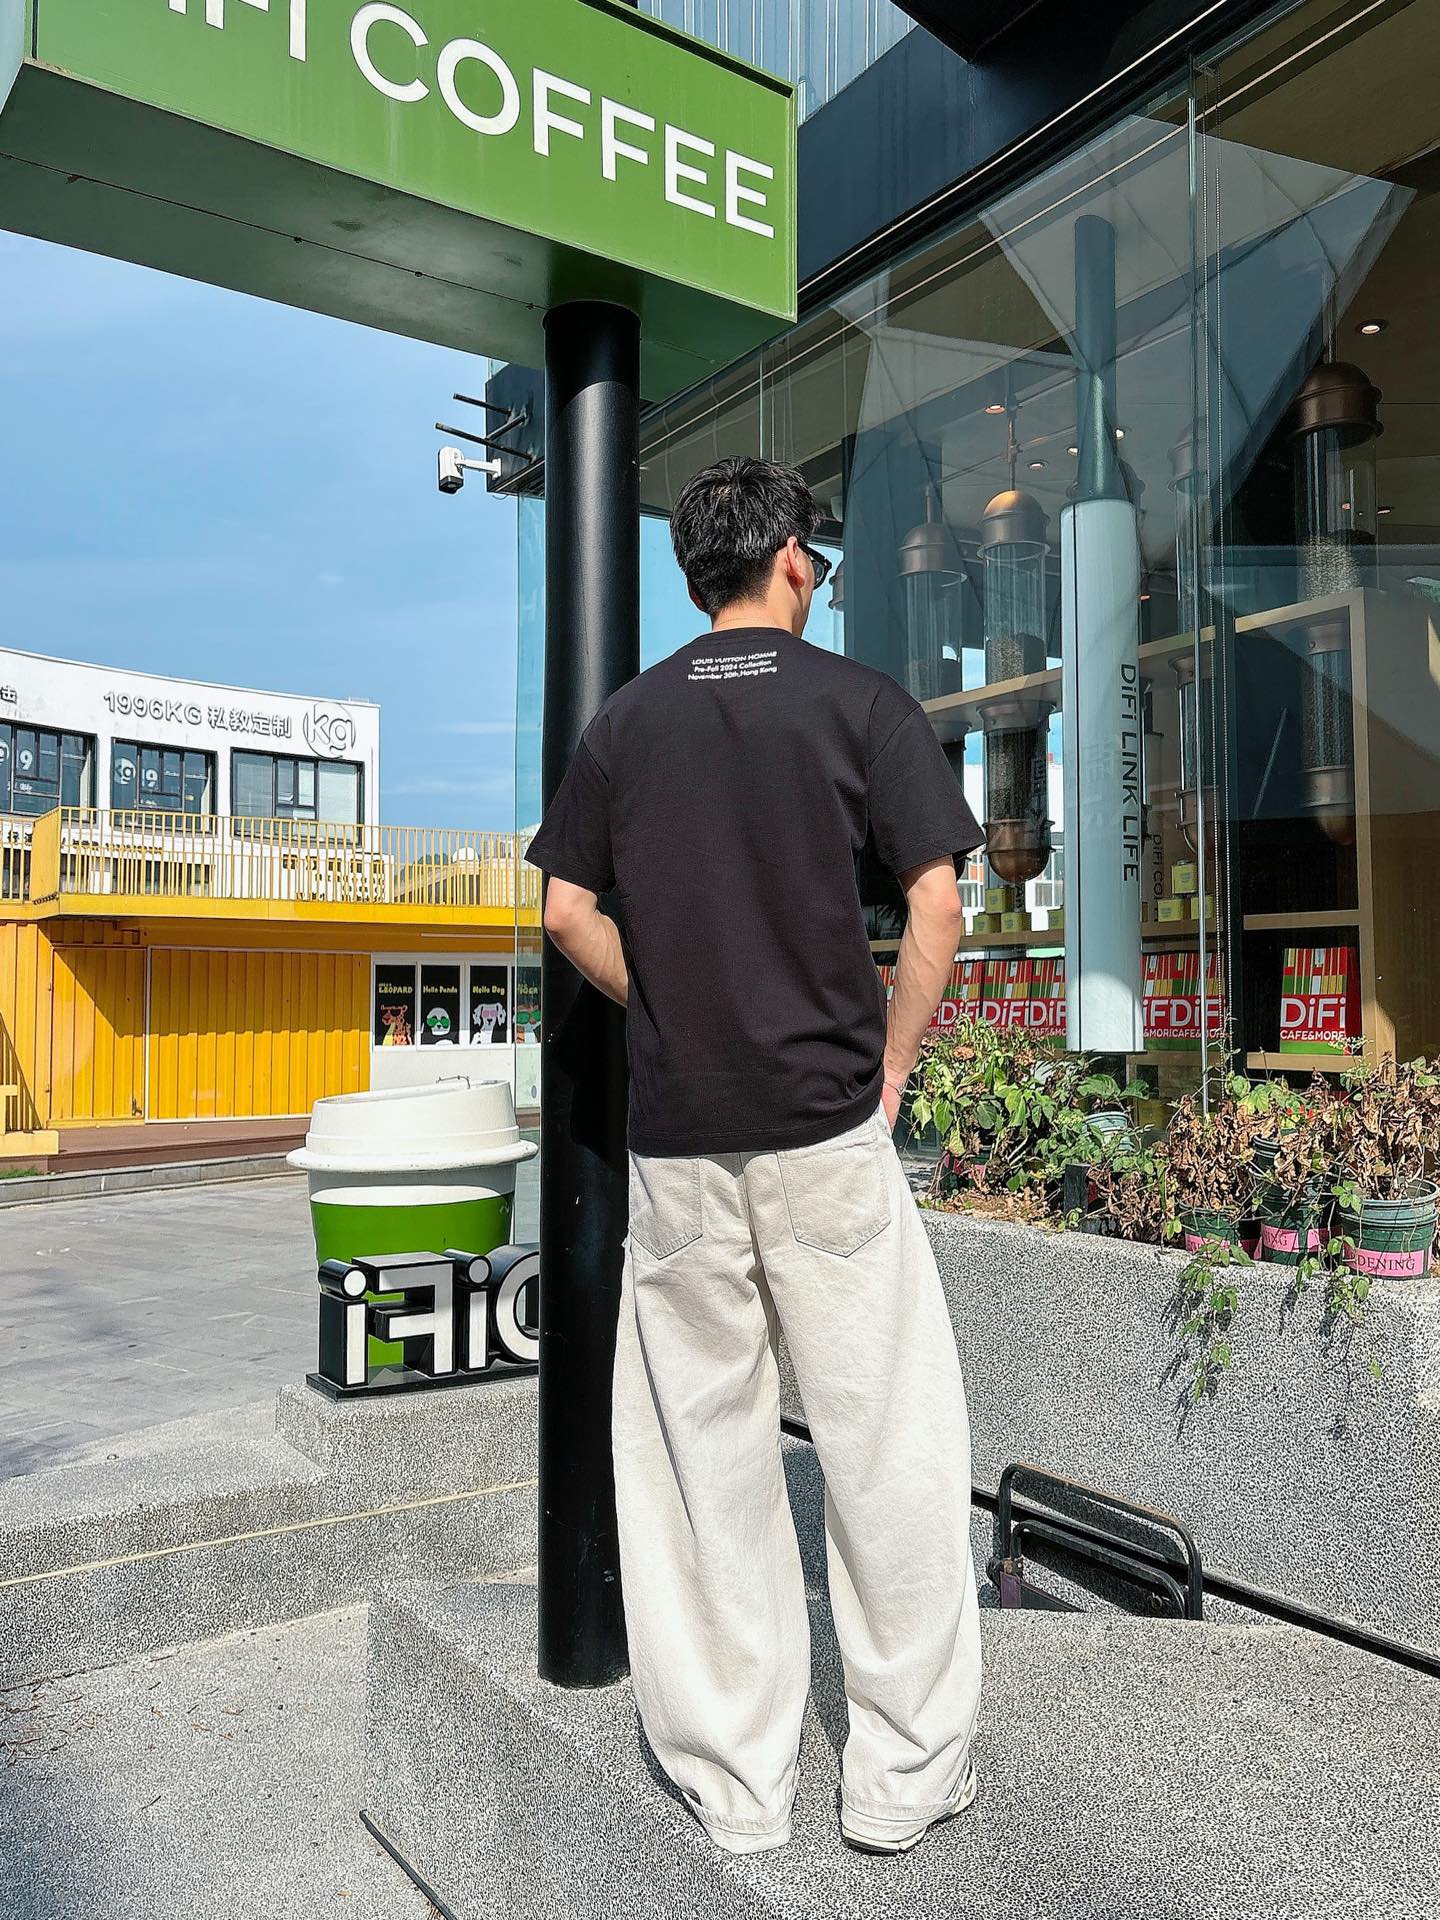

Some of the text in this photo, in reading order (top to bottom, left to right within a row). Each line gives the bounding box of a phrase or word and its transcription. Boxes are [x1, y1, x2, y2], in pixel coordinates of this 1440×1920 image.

[349, 1, 776, 239] COFFEE
[719, 663, 738, 671] 2024
[739, 660, 772, 669] Collection
[747, 651, 777, 660] HOMME
[104, 691, 202, 726] 1996KG
[207, 705, 292, 738] 私教定制
[1120, 663, 1139, 882] DiFi LINK LIFE
[491, 985, 505, 996] Dog
[983, 1001, 1029, 1026] DiFi
[1030, 1001, 1066, 1026] DiF
[1280, 997, 1346, 1028] DiFi
[1357, 1255, 1415, 1271] DENING
